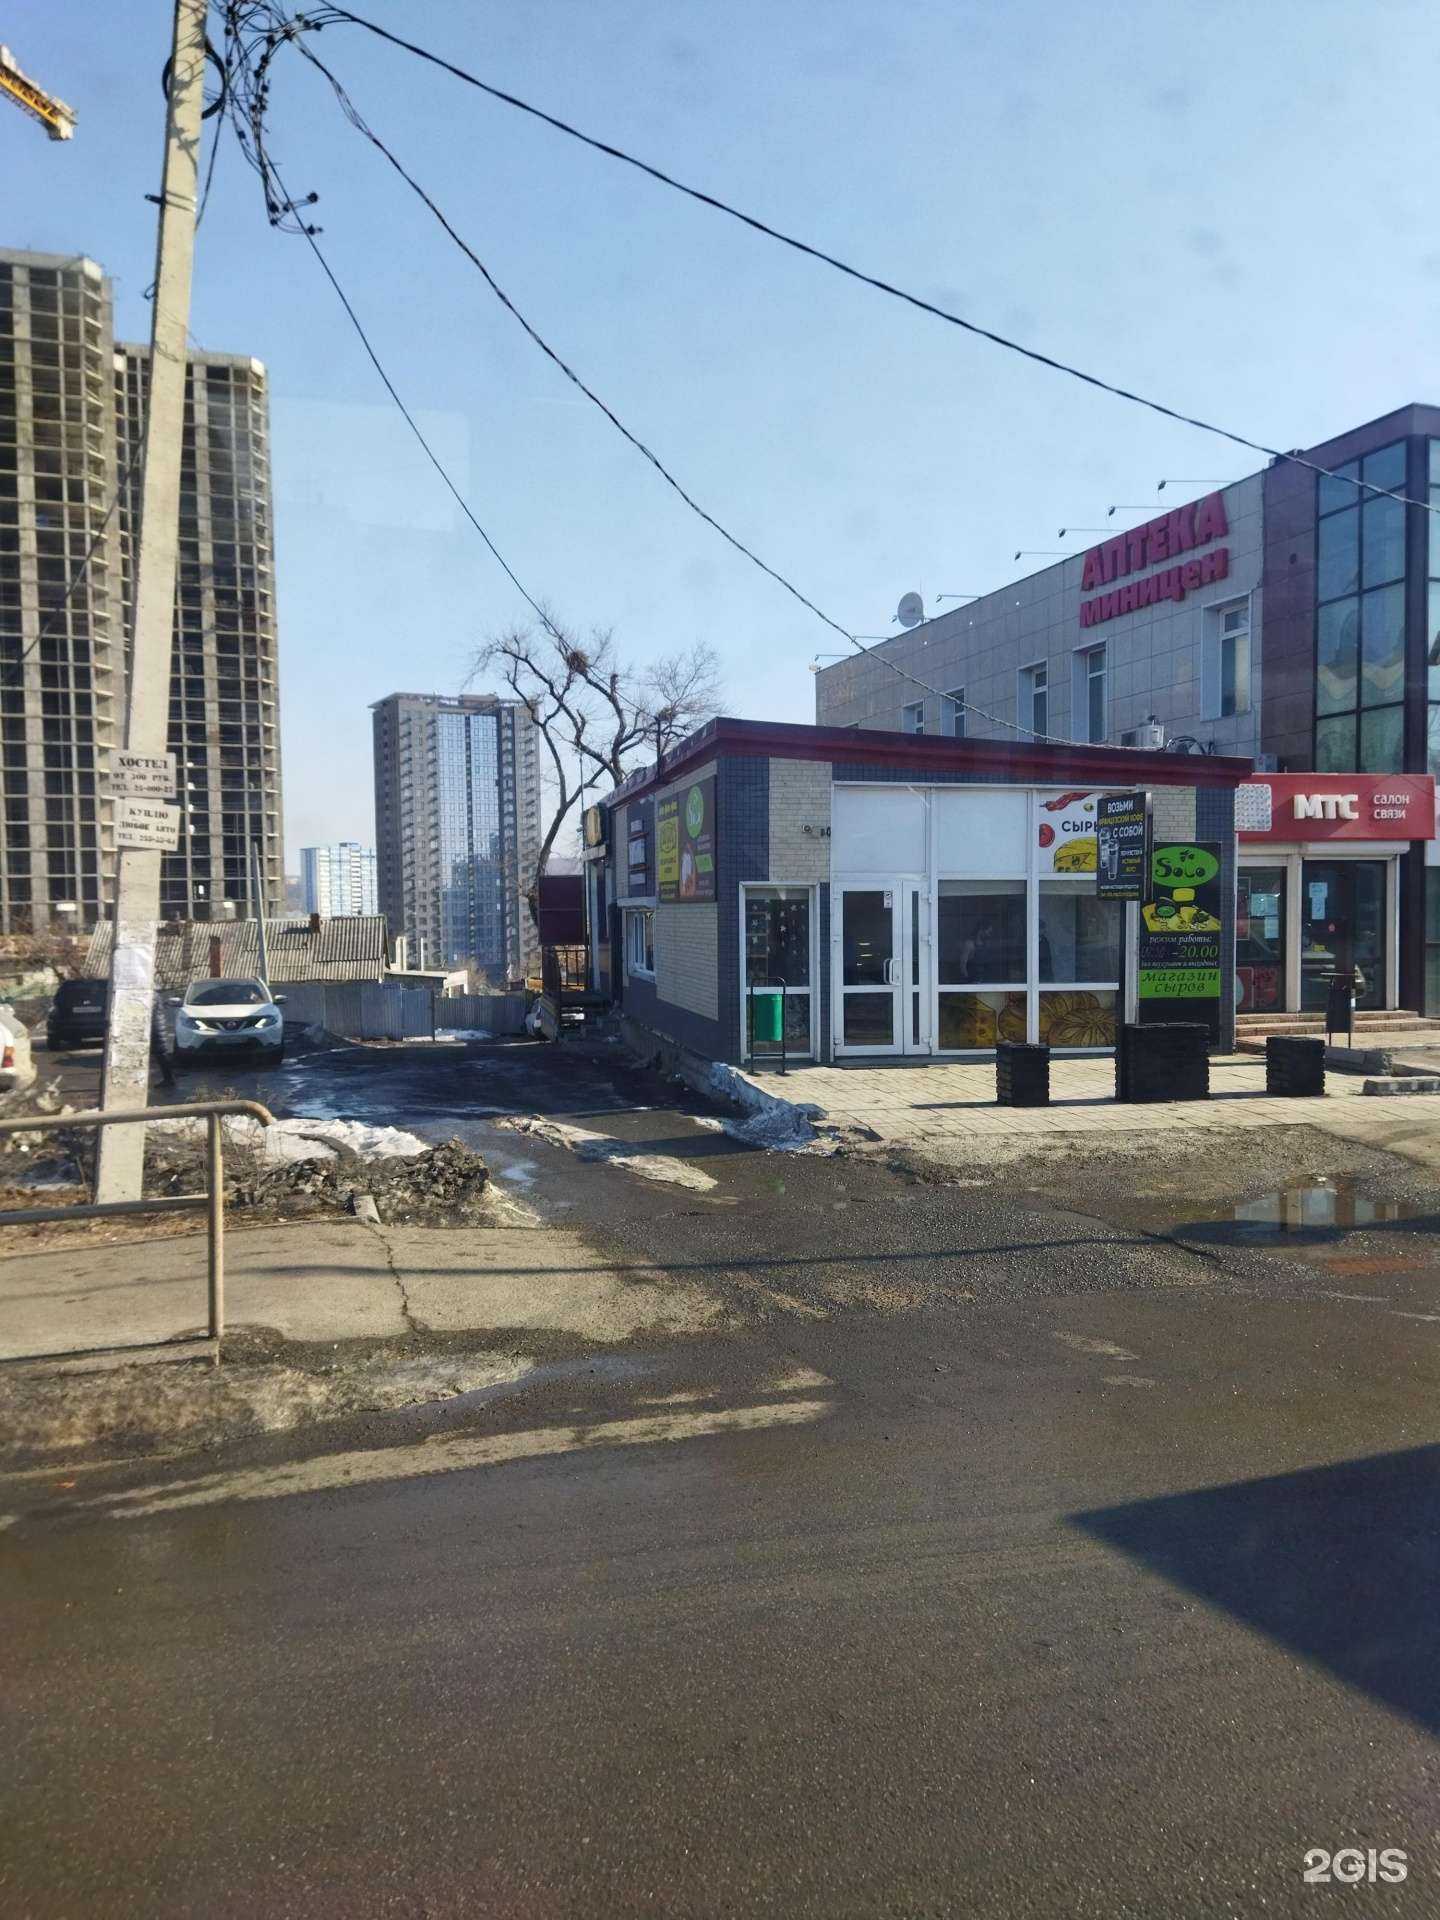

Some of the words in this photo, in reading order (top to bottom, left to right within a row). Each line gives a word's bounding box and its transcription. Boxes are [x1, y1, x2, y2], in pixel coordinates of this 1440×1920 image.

[1081, 491, 1229, 591] АПТЕКА
[118, 757, 168, 769] ХОСТЕЛ
[1373, 795, 1410, 804] салон
[1107, 800, 1134, 813] ВОЗЬМИ
[1294, 794, 1359, 819] МТС
[1373, 808, 1406, 819] связи
[1113, 827, 1118, 838] С
[1119, 823, 1143, 837] СОБОЙ
[1178, 933, 1213, 945] работы:
[1142, 971, 1217, 982] магазин
[1155, 982, 1206, 997] сыров
